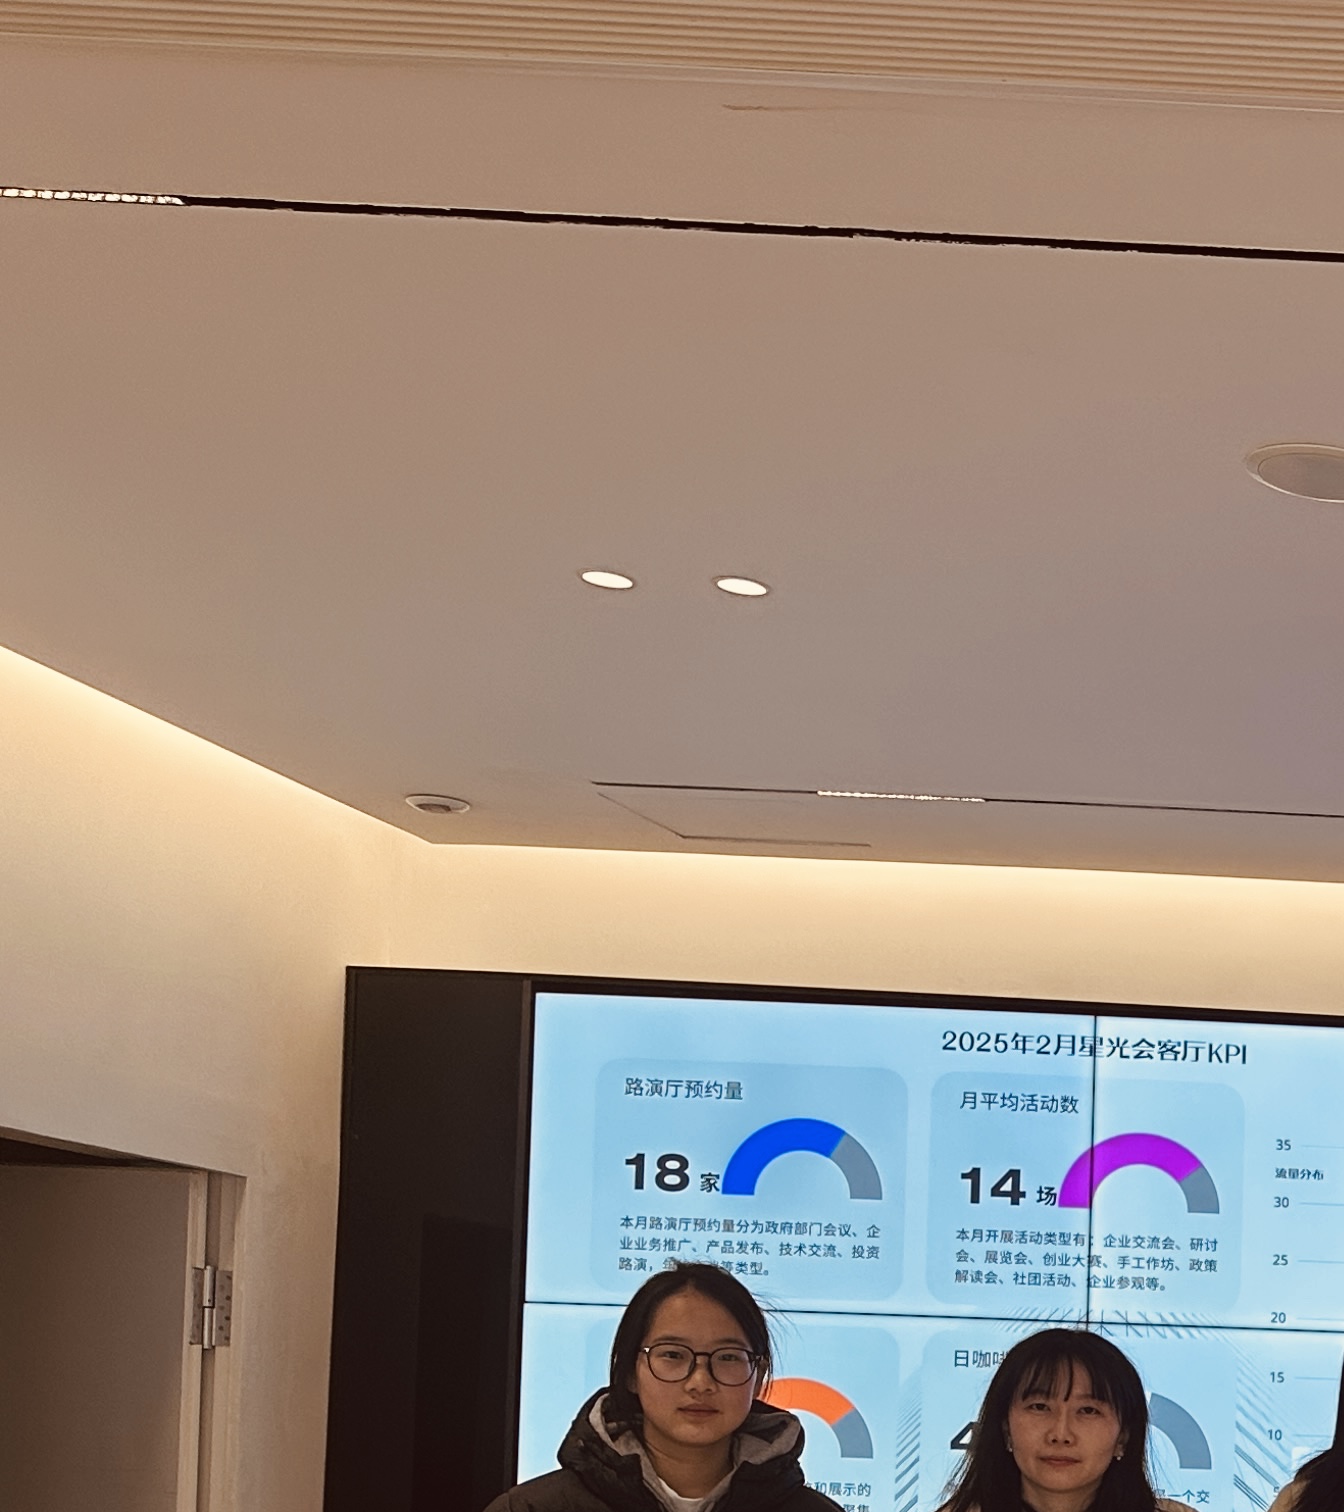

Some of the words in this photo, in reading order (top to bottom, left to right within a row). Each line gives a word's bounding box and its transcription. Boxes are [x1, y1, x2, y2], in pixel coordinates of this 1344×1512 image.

[942, 1030, 1247, 1065] 2025年2月星光会客厅KPI
[624, 1077, 743, 1100] 路演厅预约量
[960, 1090, 1079, 1114] 月平均活动数
[1275, 1139, 1291, 1151] 35
[625, 1153, 690, 1192] 18
[700, 1172, 720, 1193] 家
[961, 1167, 1026, 1206] 14
[1037, 1186, 1057, 1206] 场
[1273, 1196, 1289, 1209] 30
[1272, 1254, 1288, 1267] 25
[1270, 1312, 1286, 1324] 20
[1270, 1371, 1285, 1383] 15
[1267, 1429, 1282, 1441] 10
